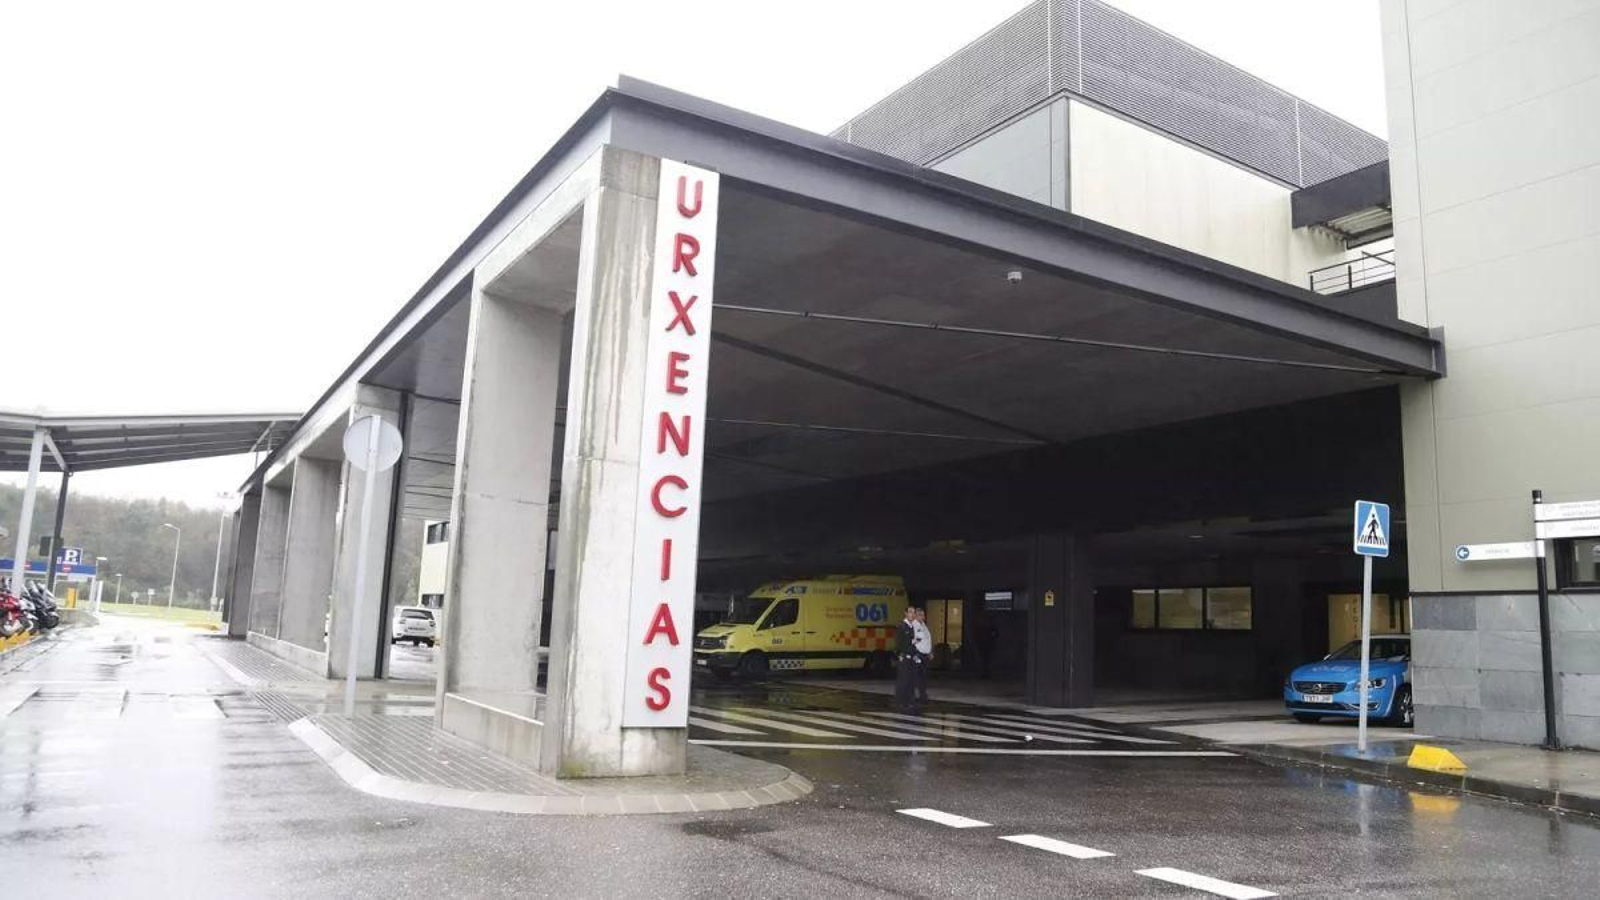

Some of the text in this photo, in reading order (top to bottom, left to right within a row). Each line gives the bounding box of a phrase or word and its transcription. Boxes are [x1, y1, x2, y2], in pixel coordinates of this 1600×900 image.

[644, 175, 703, 711] URXENCIAS
[65, 549, 78, 562] P
[855, 602, 888, 622] 061
